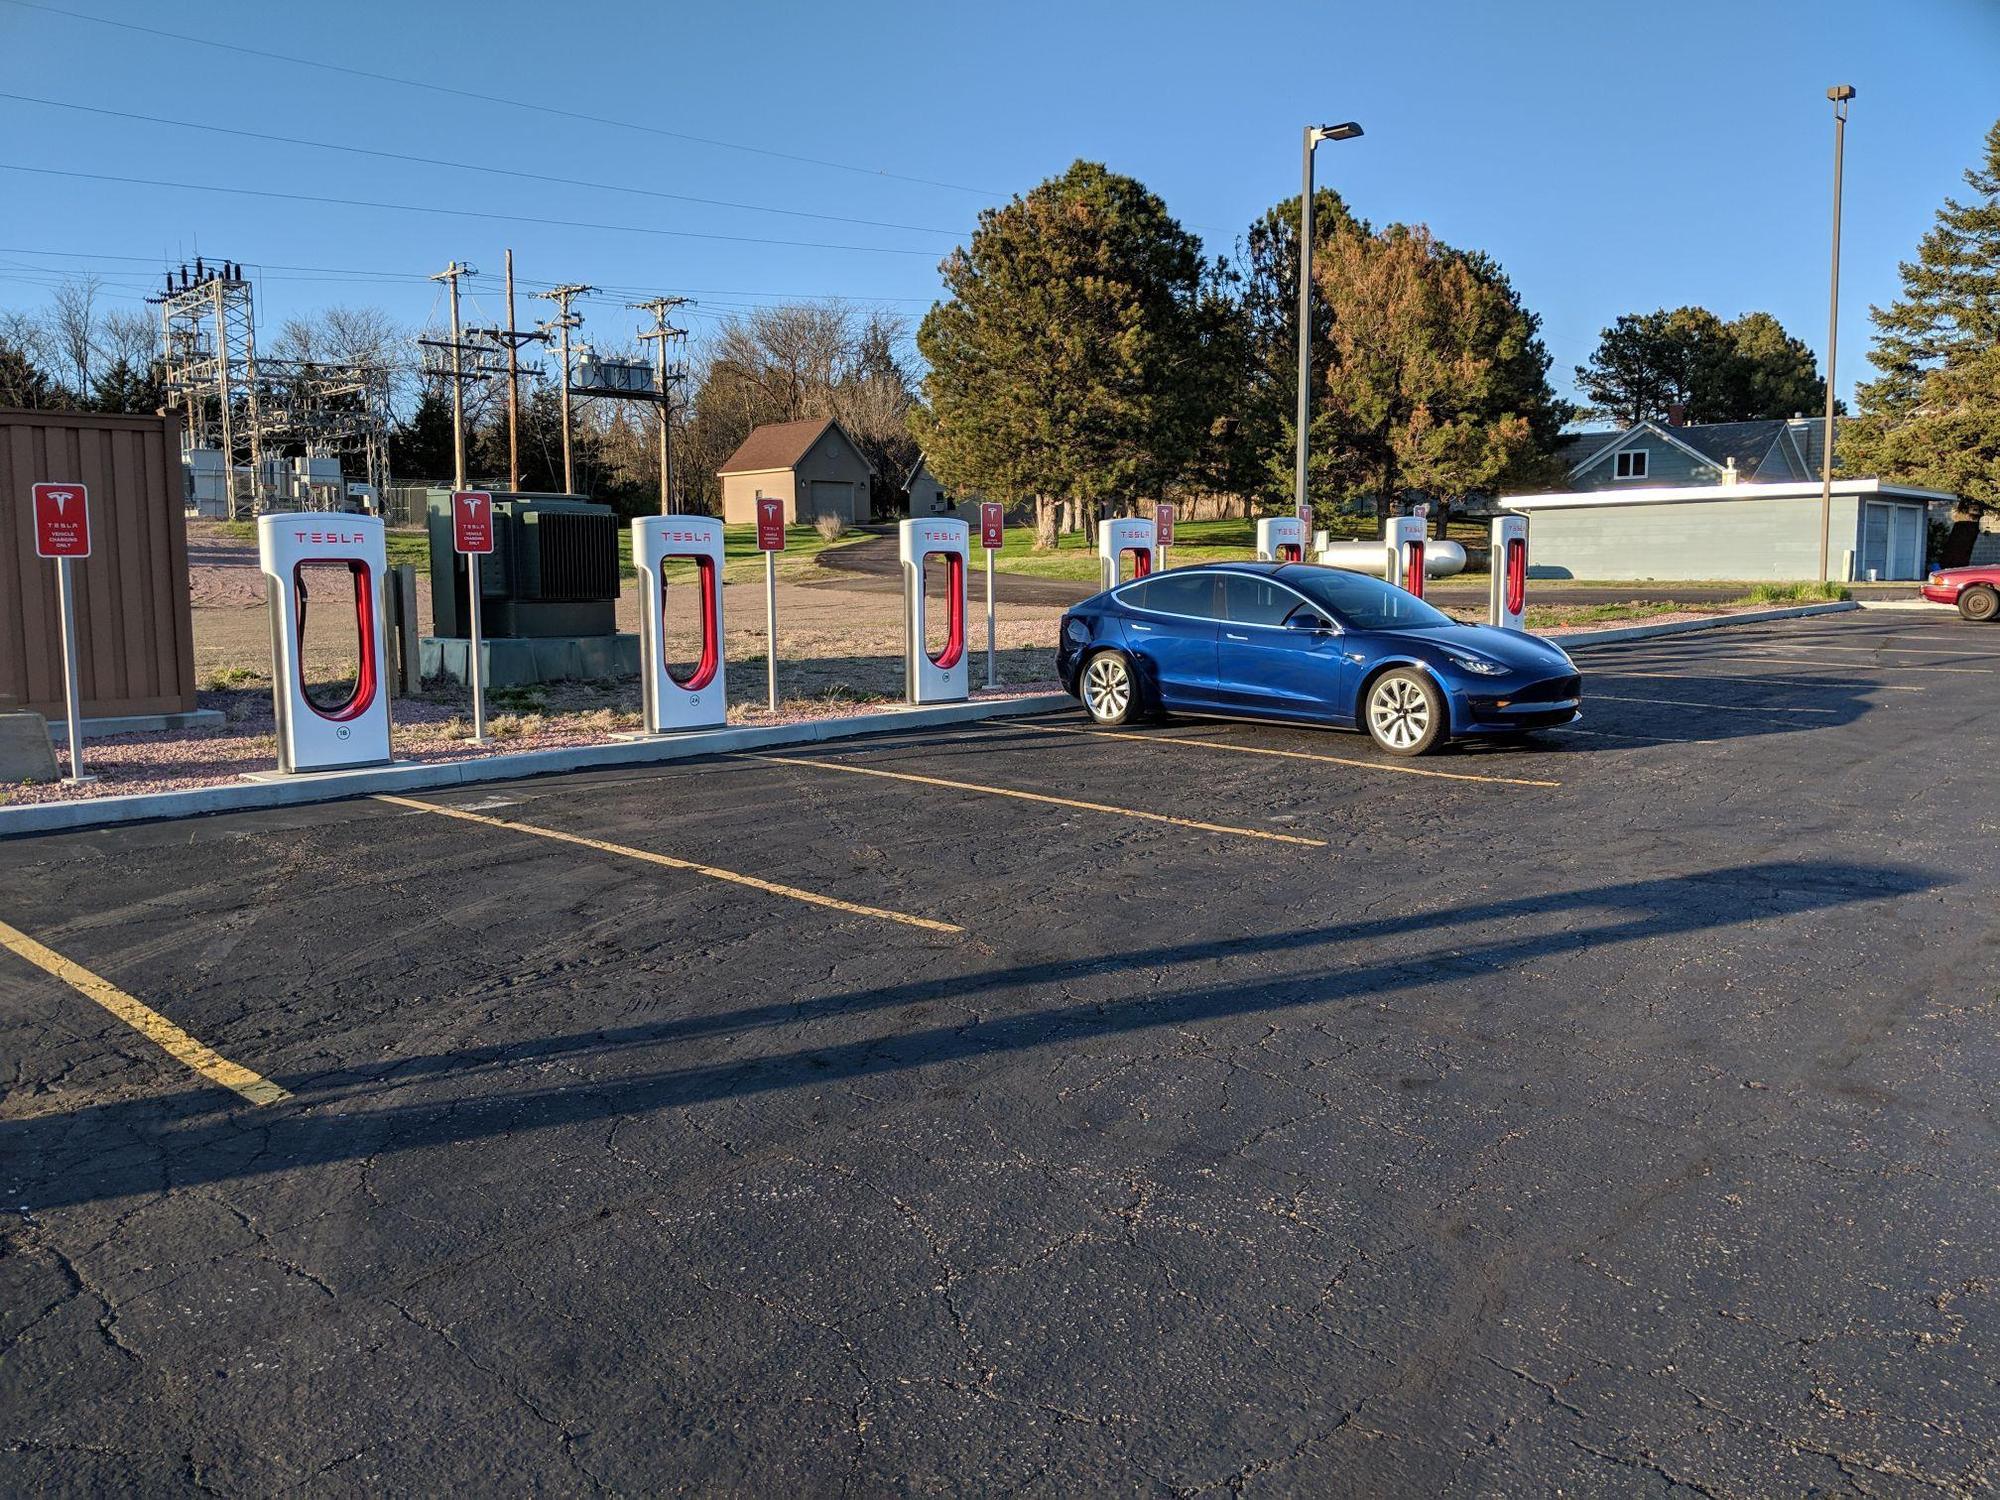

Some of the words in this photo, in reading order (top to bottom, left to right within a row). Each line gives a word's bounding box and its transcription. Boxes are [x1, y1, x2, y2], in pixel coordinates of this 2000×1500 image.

[661, 532, 711, 541] TESLA
[924, 532, 961, 541] TESLA
[1120, 531, 1150, 539] TESLA
[1278, 528, 1300, 536] TESLA
[294, 532, 364, 543] TESLA
